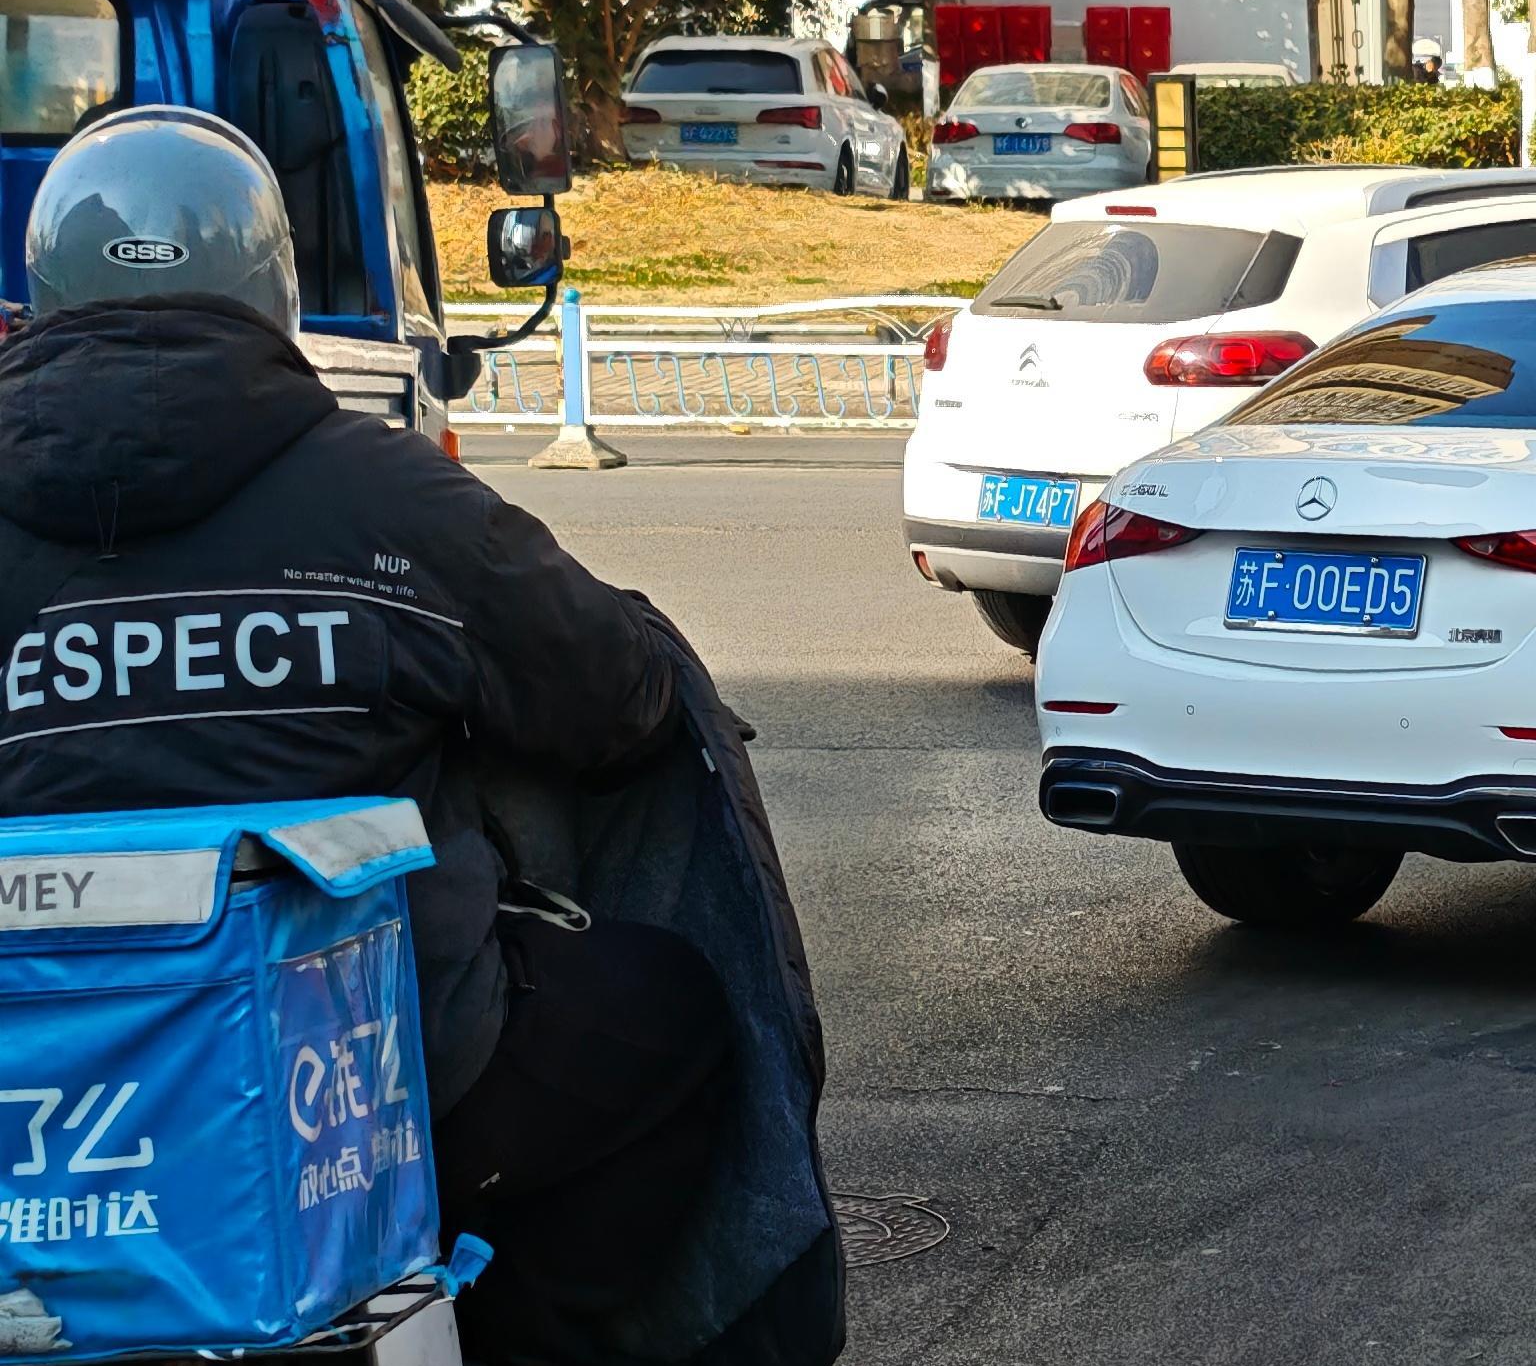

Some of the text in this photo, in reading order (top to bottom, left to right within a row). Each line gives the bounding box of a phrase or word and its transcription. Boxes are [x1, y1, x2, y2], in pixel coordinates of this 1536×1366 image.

[283, 568, 302, 580] No
[305, 571, 345, 583] matter
[346, 576, 375, 590] what
[377, 583, 393, 594] we
[373, 552, 411, 575] NUP
[5, 611, 350, 712] ESPECT
[0, 871, 95, 912] MEY
[0, 1189, 160, 1243] 准时达
